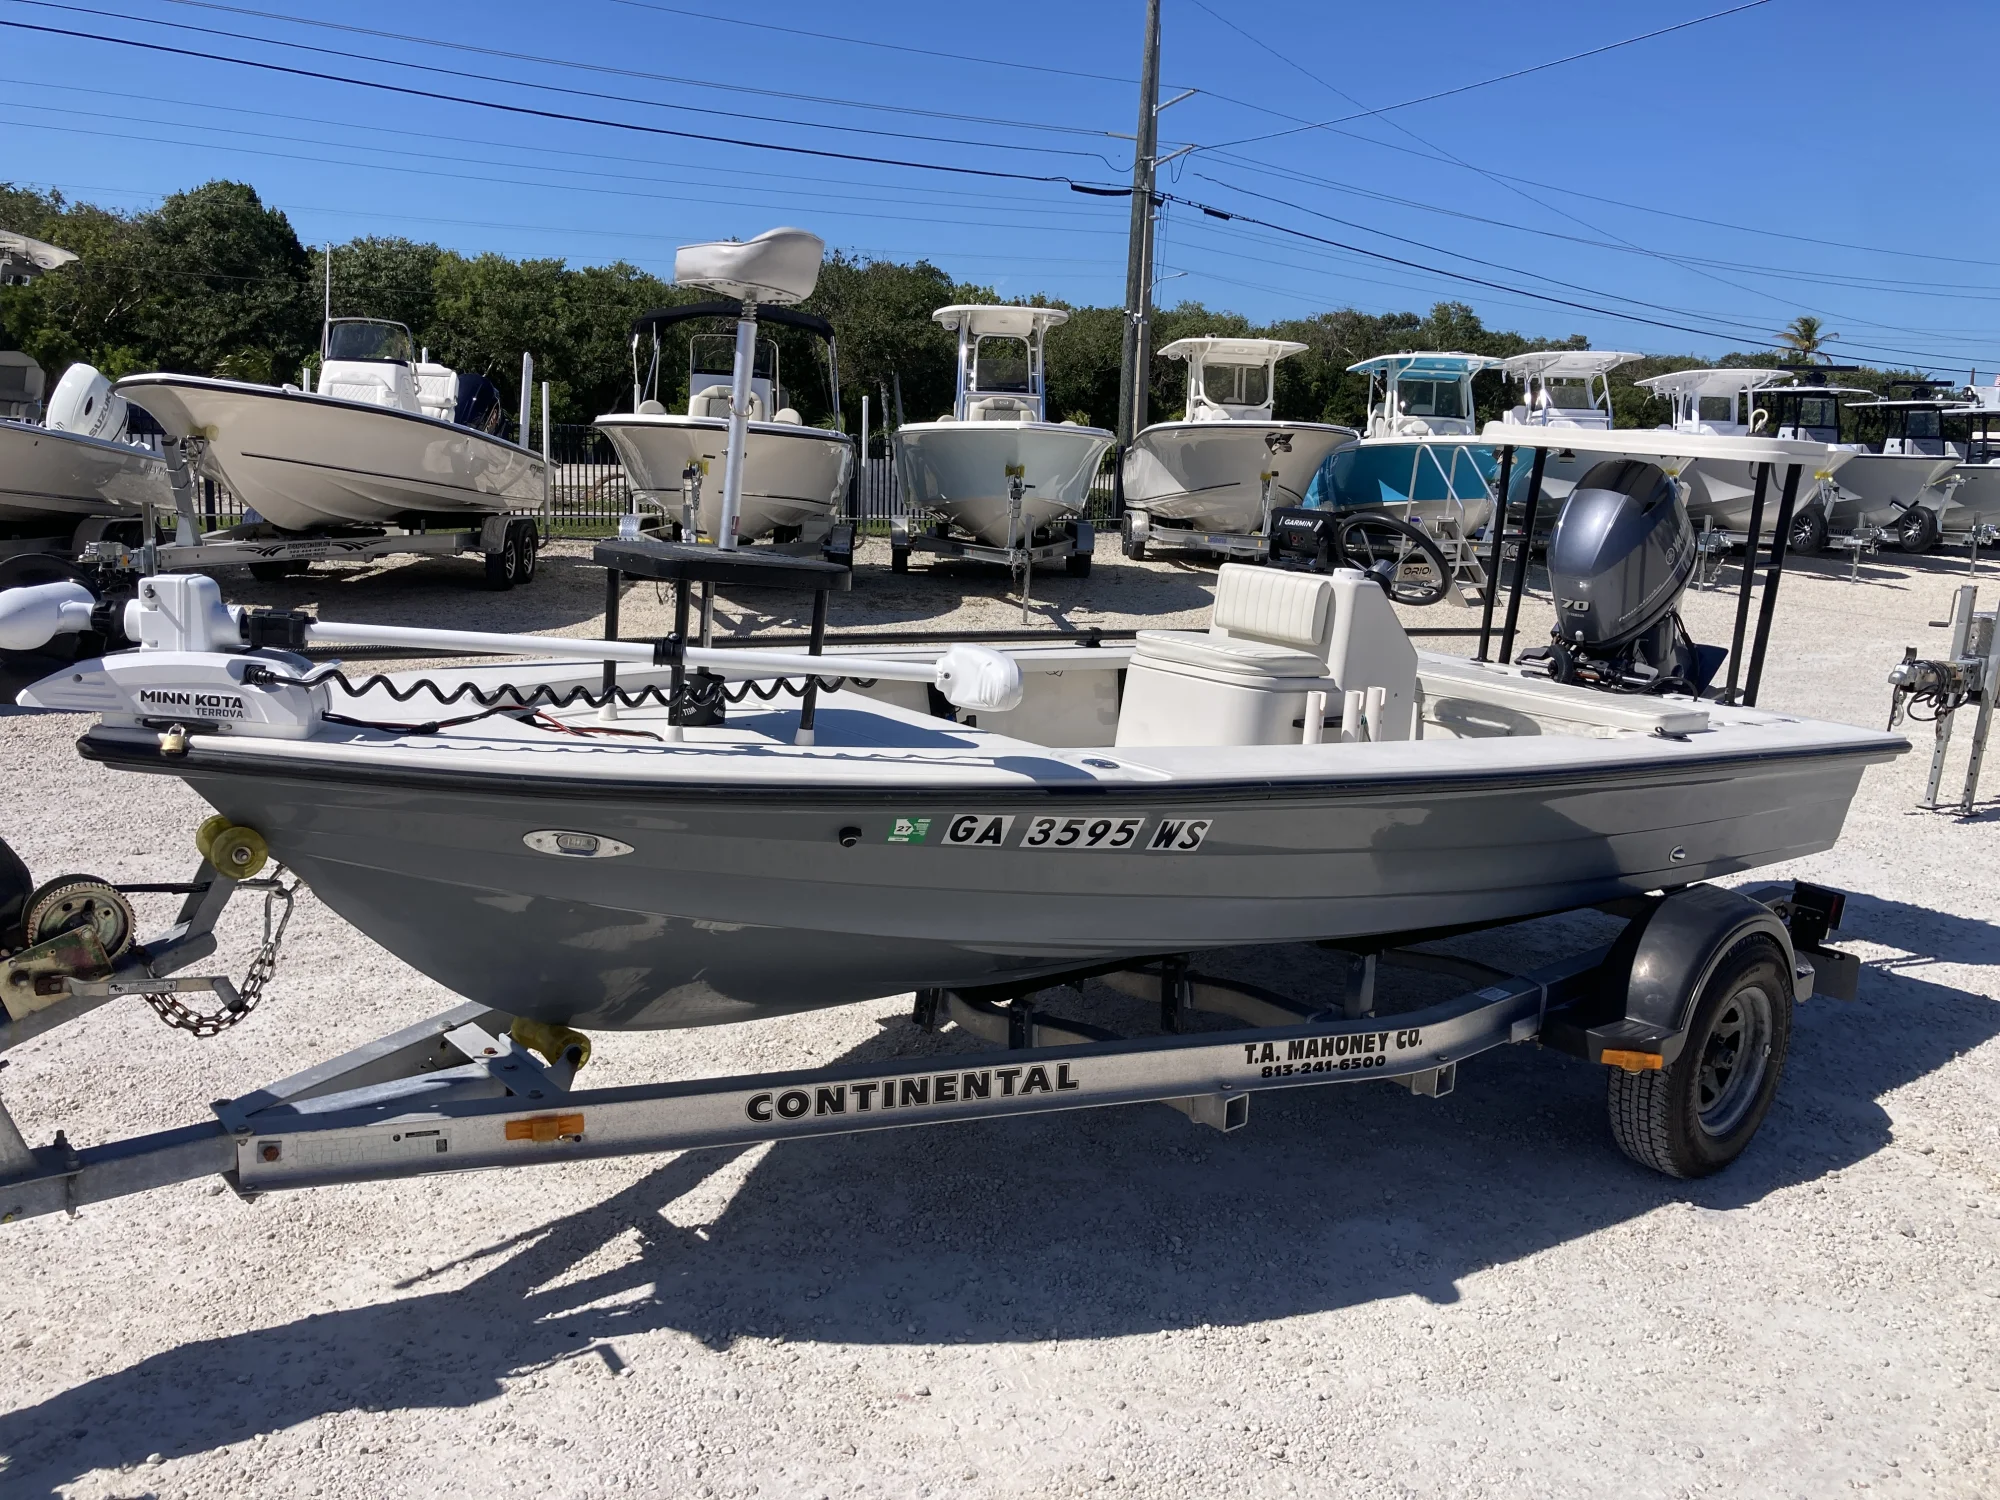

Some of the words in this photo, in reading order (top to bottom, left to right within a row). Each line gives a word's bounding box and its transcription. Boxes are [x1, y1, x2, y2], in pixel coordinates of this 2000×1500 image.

[89, 388, 111, 437] SUZUK
[1284, 518, 1313, 528] GARMIN
[1560, 597, 1589, 611] 70
[140, 690, 190, 705] MINN
[195, 694, 244, 709] KOTA
[195, 707, 244, 719] TERROVA
[949, 815, 1003, 845] GA
[1027, 818, 1141, 846] 3595
[1152, 820, 1208, 849] WS
[1244, 1043, 1280, 1065] T.A.
[1287, 1032, 1390, 1061] MAHONEY
[1396, 1029, 1423, 1050] CO.
[1261, 1055, 1386, 1079] 813-241-6500
[745, 1062, 1080, 1123] CONTINENTAL
